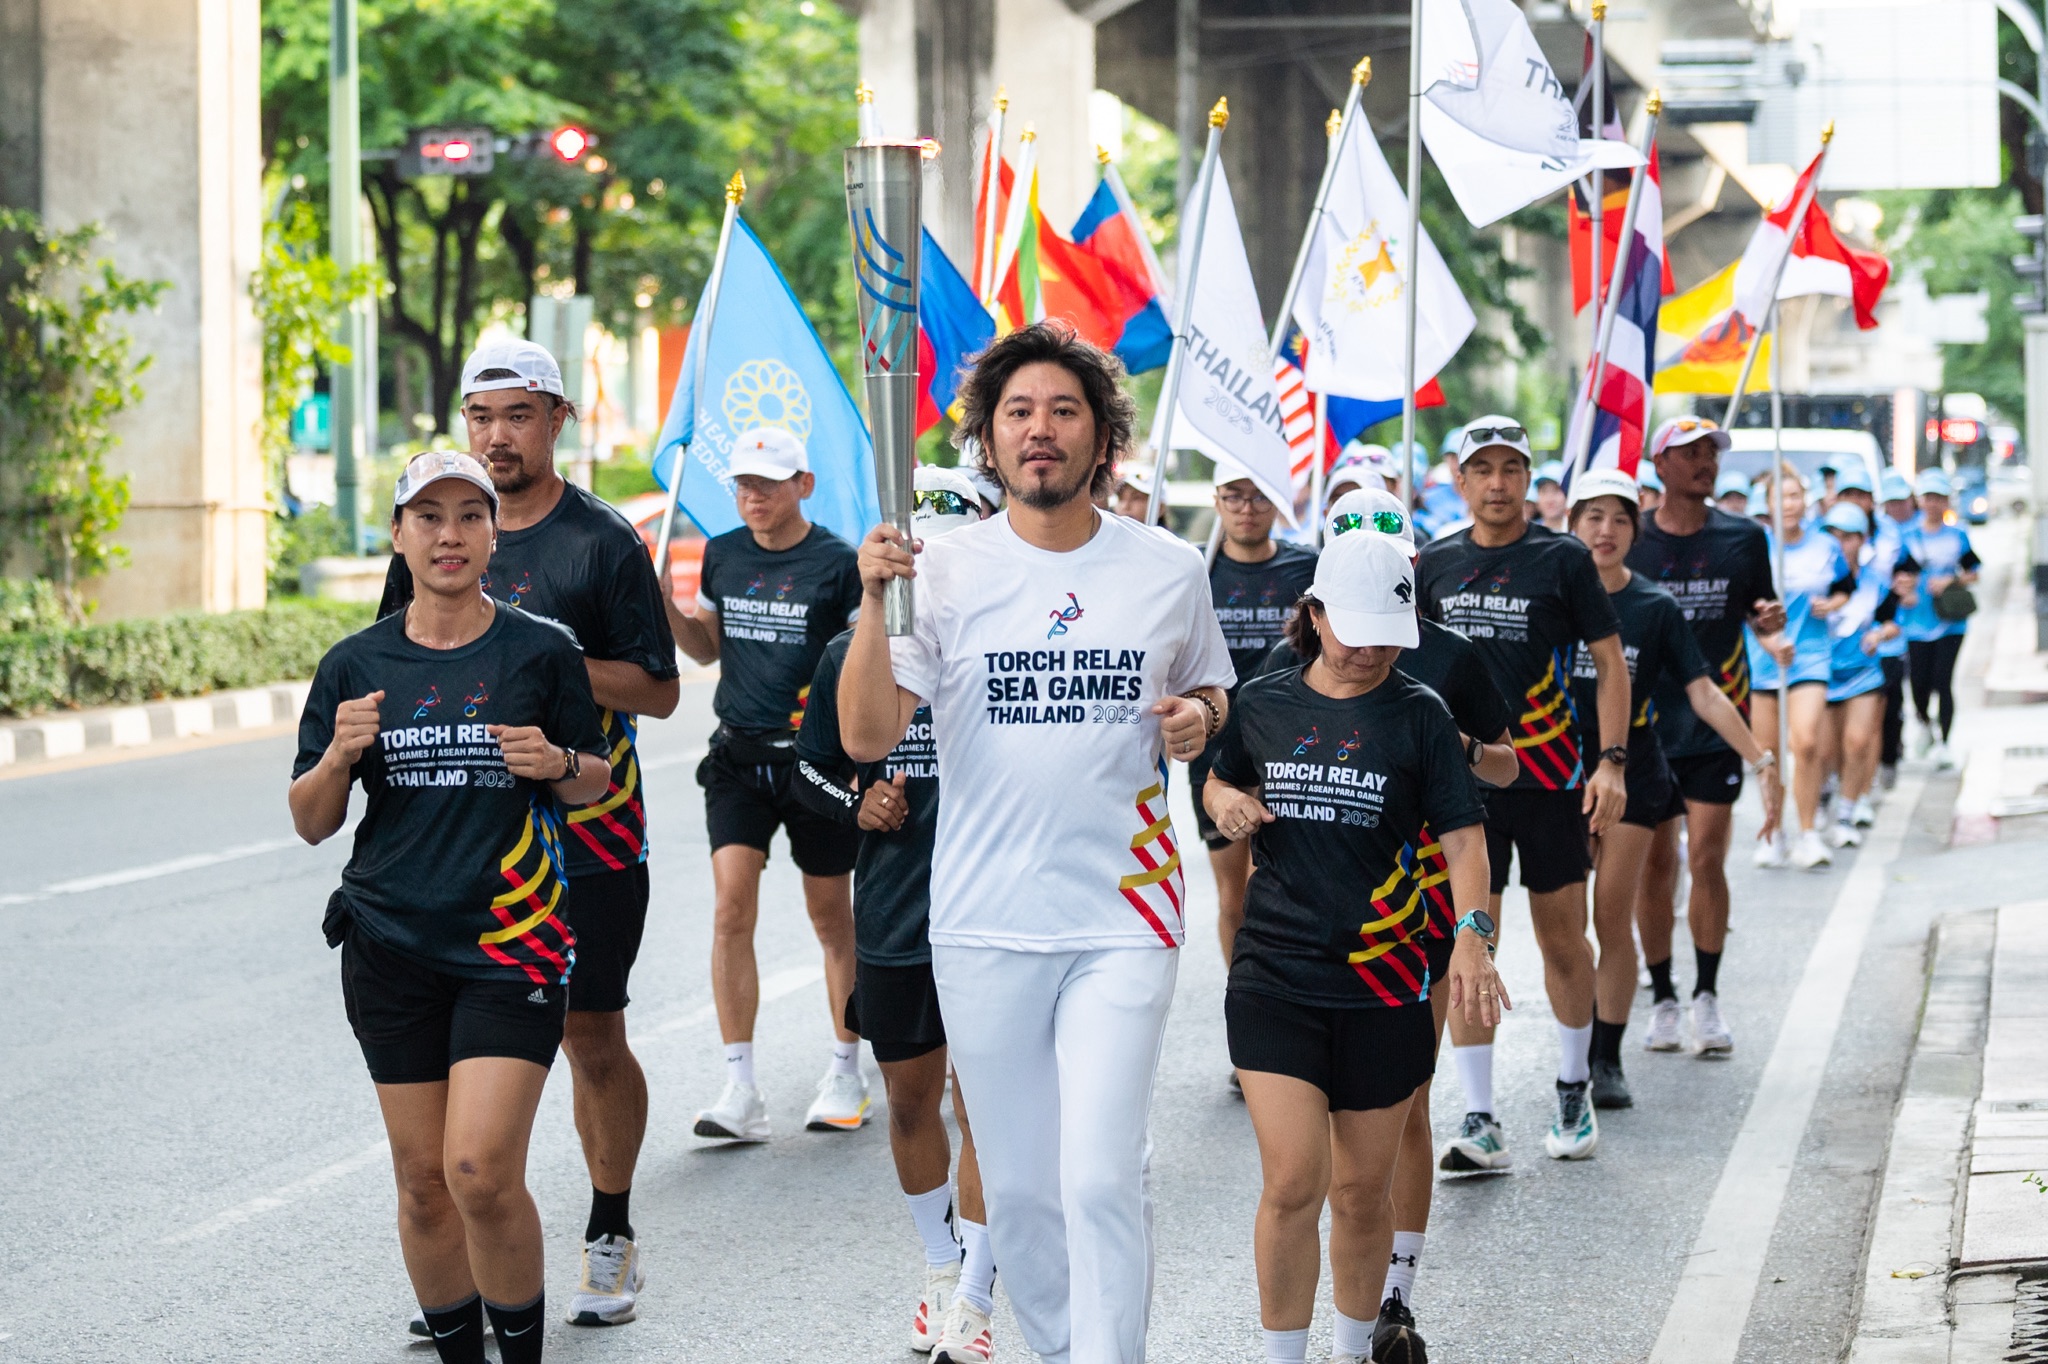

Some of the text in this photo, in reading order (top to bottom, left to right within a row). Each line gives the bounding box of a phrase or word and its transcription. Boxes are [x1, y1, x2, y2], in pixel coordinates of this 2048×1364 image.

[1188, 323, 1289, 445] THAILAN
[1203, 384, 1254, 436] 2025
[1687, 578, 1730, 593] RELAY
[722, 595, 809, 618] TORCH RELAY
[1483, 594, 1530, 613] RELAY
[723, 625, 777, 643] THAILAND
[984, 649, 1146, 673] TORCH RELAY
[987, 675, 1143, 702] SEA GAMES
[987, 704, 1142, 724] THAILAND 2025
[380, 724, 499, 751] TORCH REL
[898, 743, 925, 753] GAMES
[384, 752, 398, 763] SEA
[399, 749, 429, 761] GAMES
[437, 747, 466, 757] ASEAN
[468, 746, 490, 757] PARA
[492, 746, 506, 757] GA
[386, 769, 516, 788] THAILAND 2025
[885, 762, 940, 779] THAILA
[1265, 762, 1388, 792] TORCH RELAY
[1265, 782, 1275, 790] SEA
[1275, 781, 1301, 791] GAMES
[1308, 784, 1334, 795] ASEAN
[1335, 787, 1355, 798] PARA
[1357, 790, 1385, 804] GAMES
[1266, 802, 1380, 828] THAILAND 2025
